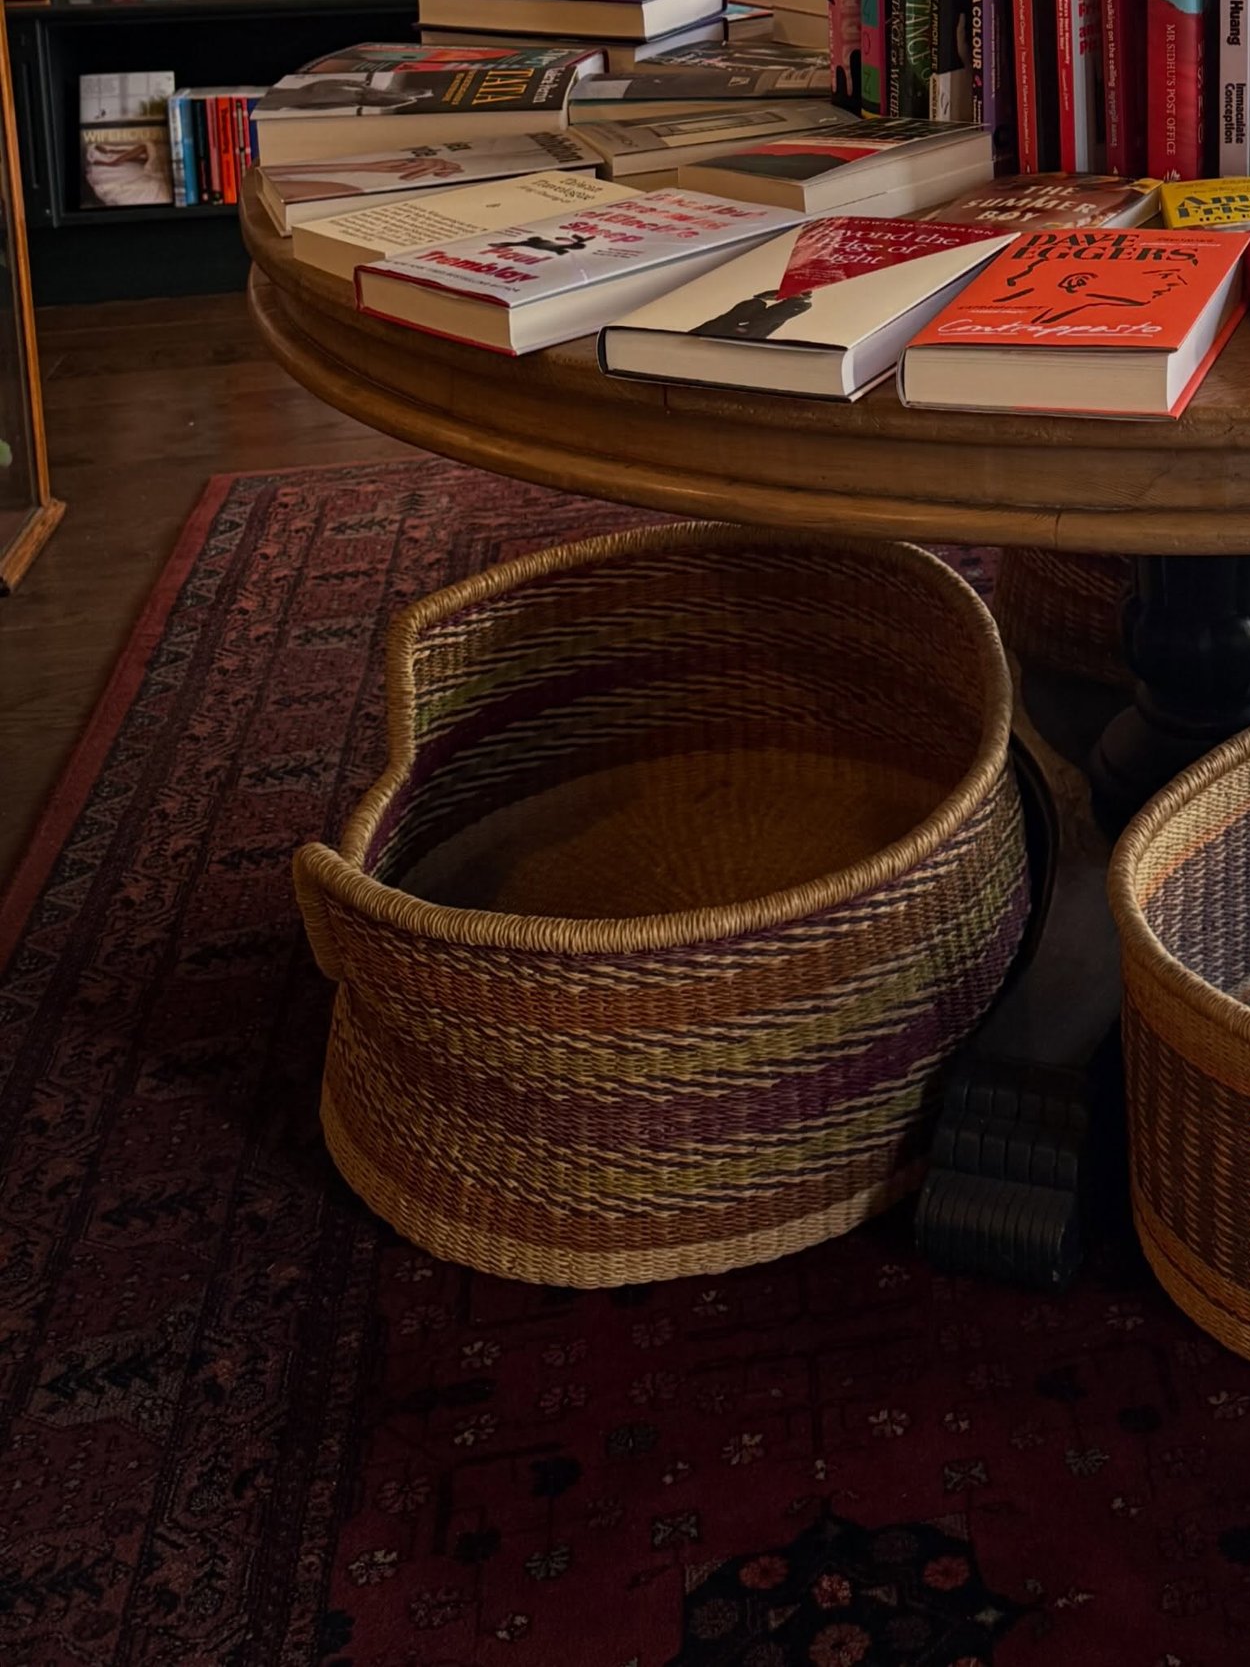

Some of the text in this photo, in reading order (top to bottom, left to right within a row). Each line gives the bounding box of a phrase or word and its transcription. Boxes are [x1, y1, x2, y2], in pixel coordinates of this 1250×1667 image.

[931, 13, 940, 45] PRIOR
[1227, 0, 1244, 46] Huang
[972, 8, 982, 70] COLOUR
[1108, 30, 1115, 42] on
[931, 47, 939, 70] LIFE
[1109, 43, 1117, 57] the
[1109, 58, 1118, 87] ceiling
[1166, 24, 1176, 156] MR SIDHU'S POST OFFICE
[1224, 83, 1236, 144] Conception
[1235, 83, 1247, 145] Immaculate
[1025, 184, 1081, 198] THE
[958, 196, 1098, 215] SUMMER
[974, 210, 1043, 222] BOY
[887, 243, 930, 255] of
[914, 231, 960, 246] the
[1026, 233, 1140, 248] DAVE
[1011, 245, 1198, 262] EGGERS
[413, 249, 541, 283] Tremblay
